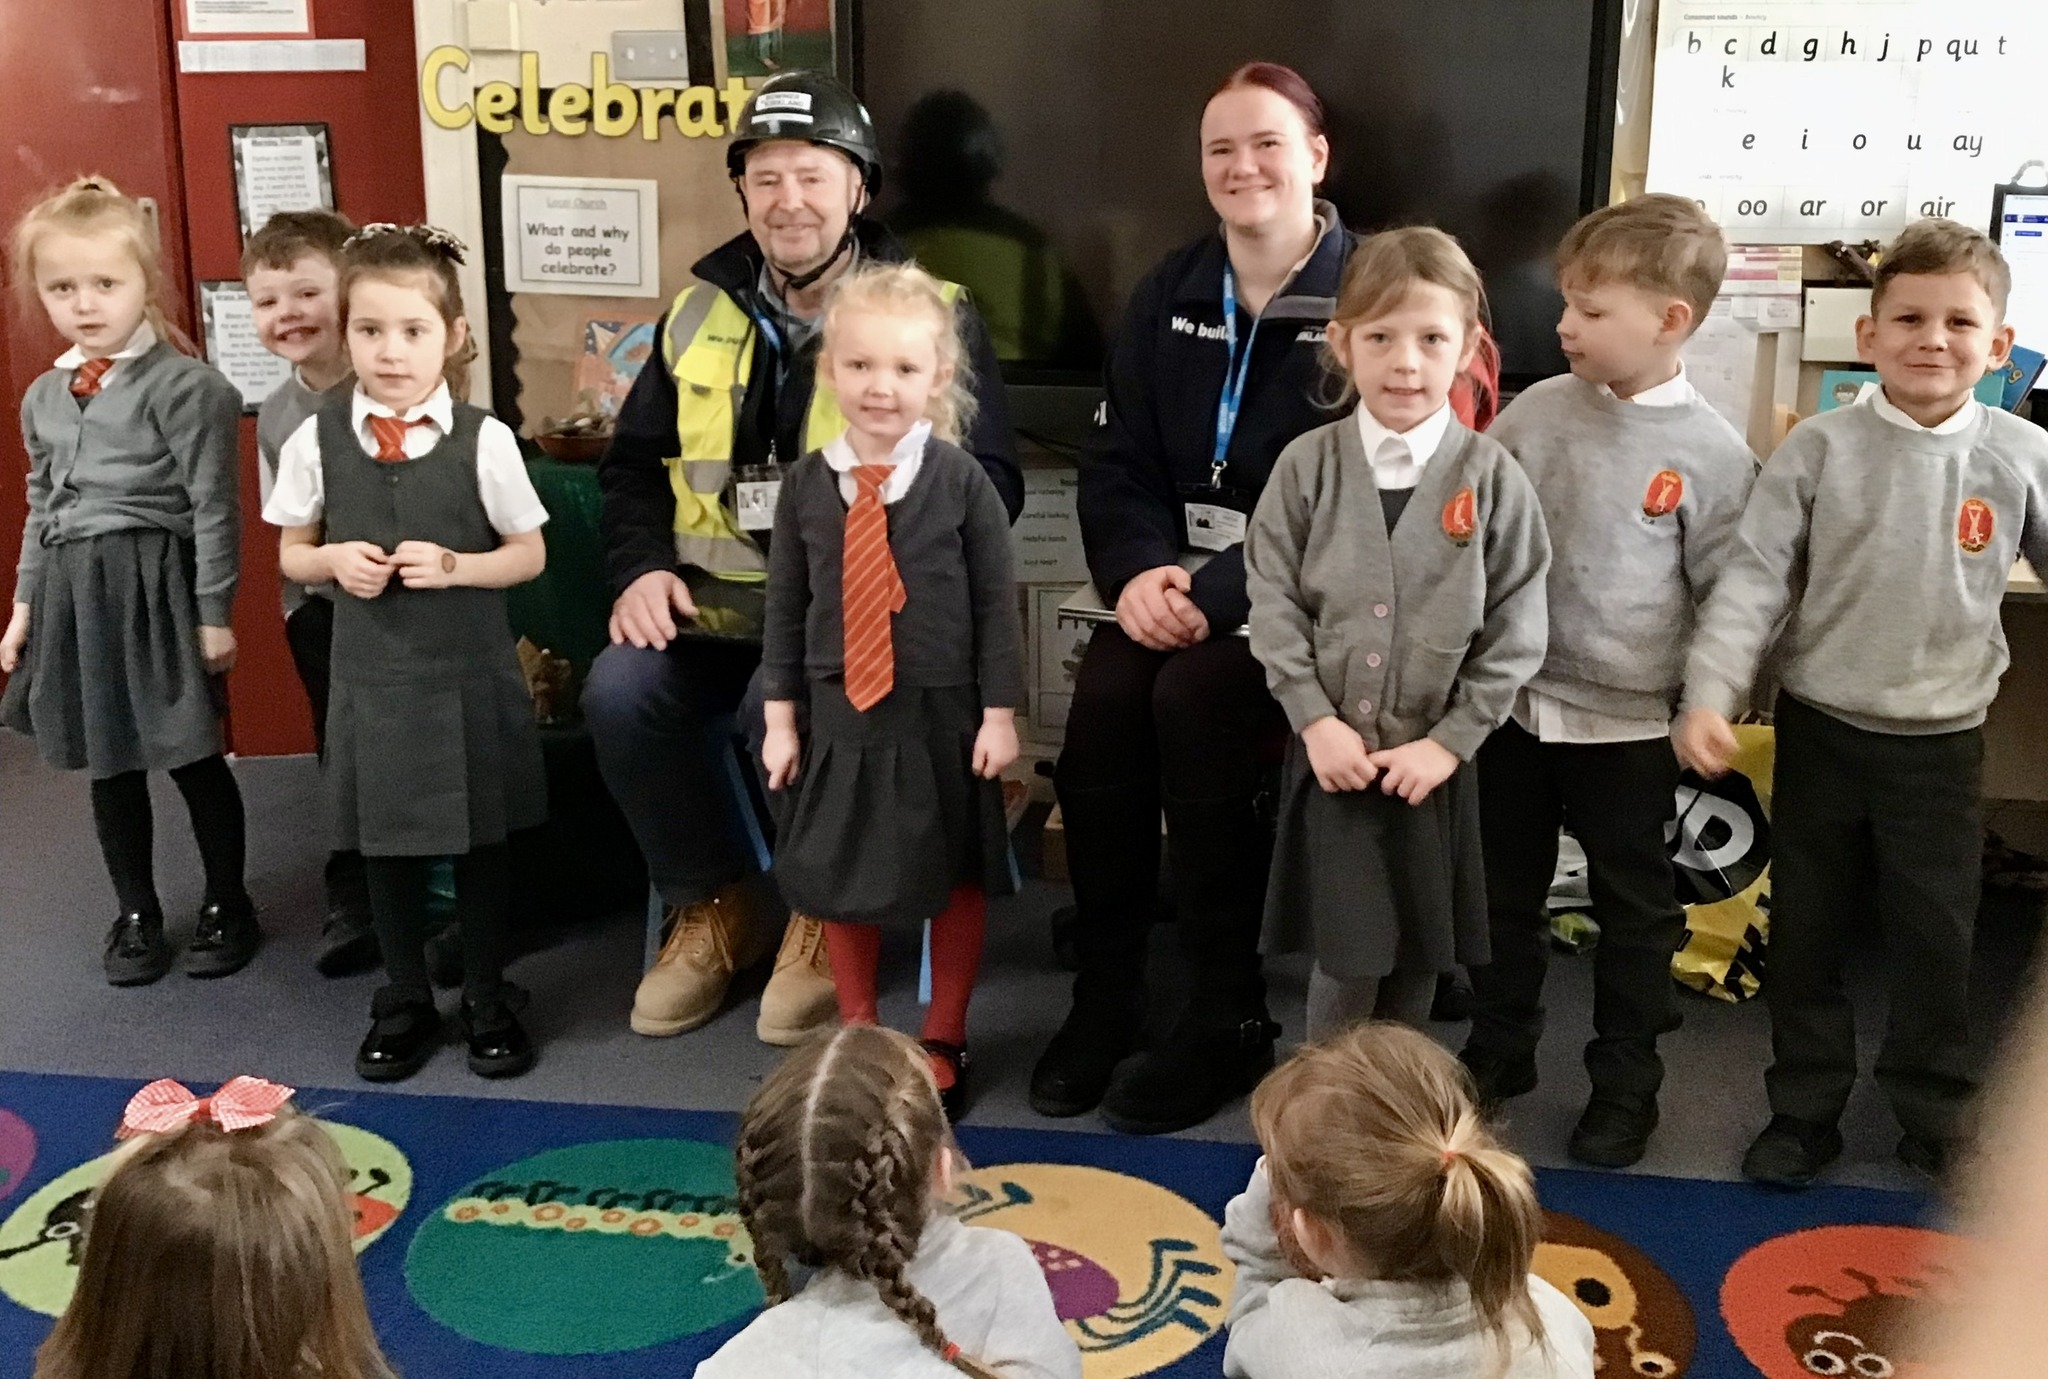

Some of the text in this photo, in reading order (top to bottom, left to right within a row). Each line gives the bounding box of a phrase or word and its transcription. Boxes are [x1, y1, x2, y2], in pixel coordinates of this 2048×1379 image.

[1687, 30, 2007, 62] b c d g h j p qu t
[1721, 65, 1736, 88] k
[1742, 128, 1984, 158] e i o u ay
[1737, 196, 1956, 218] oo ar or air
[526, 222, 630, 242] What and why
[544, 242, 612, 259] do people
[541, 261, 617, 276] celebrate?
[1171, 315, 1238, 342] We buil
